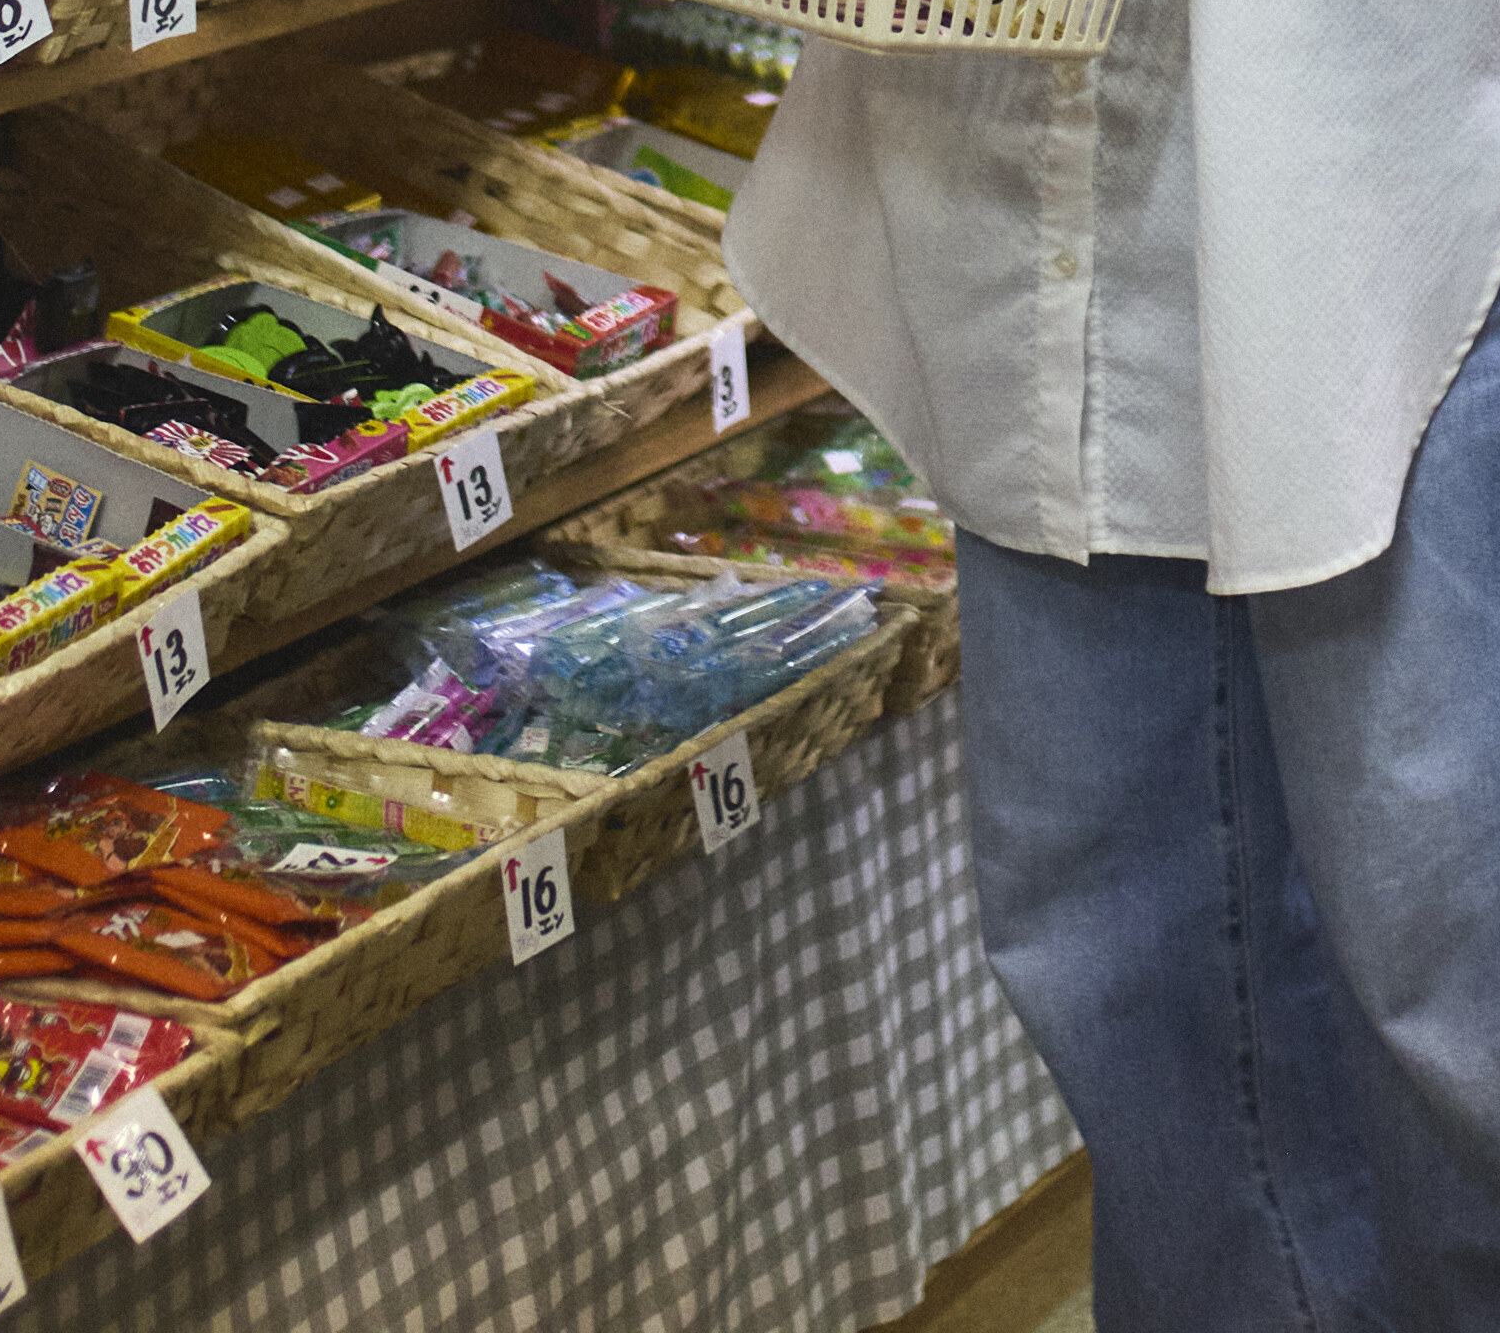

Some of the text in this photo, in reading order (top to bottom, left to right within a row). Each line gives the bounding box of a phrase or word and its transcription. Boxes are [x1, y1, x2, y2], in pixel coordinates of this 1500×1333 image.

[423, 375, 508, 423] おやつカルパス
[457, 465, 492, 520] 13
[131, 512, 219, 575] おやつカルパス
[155, 627, 189, 696] 13
[712, 762, 745, 823] 16
[522, 865, 564, 934] 16 エン
